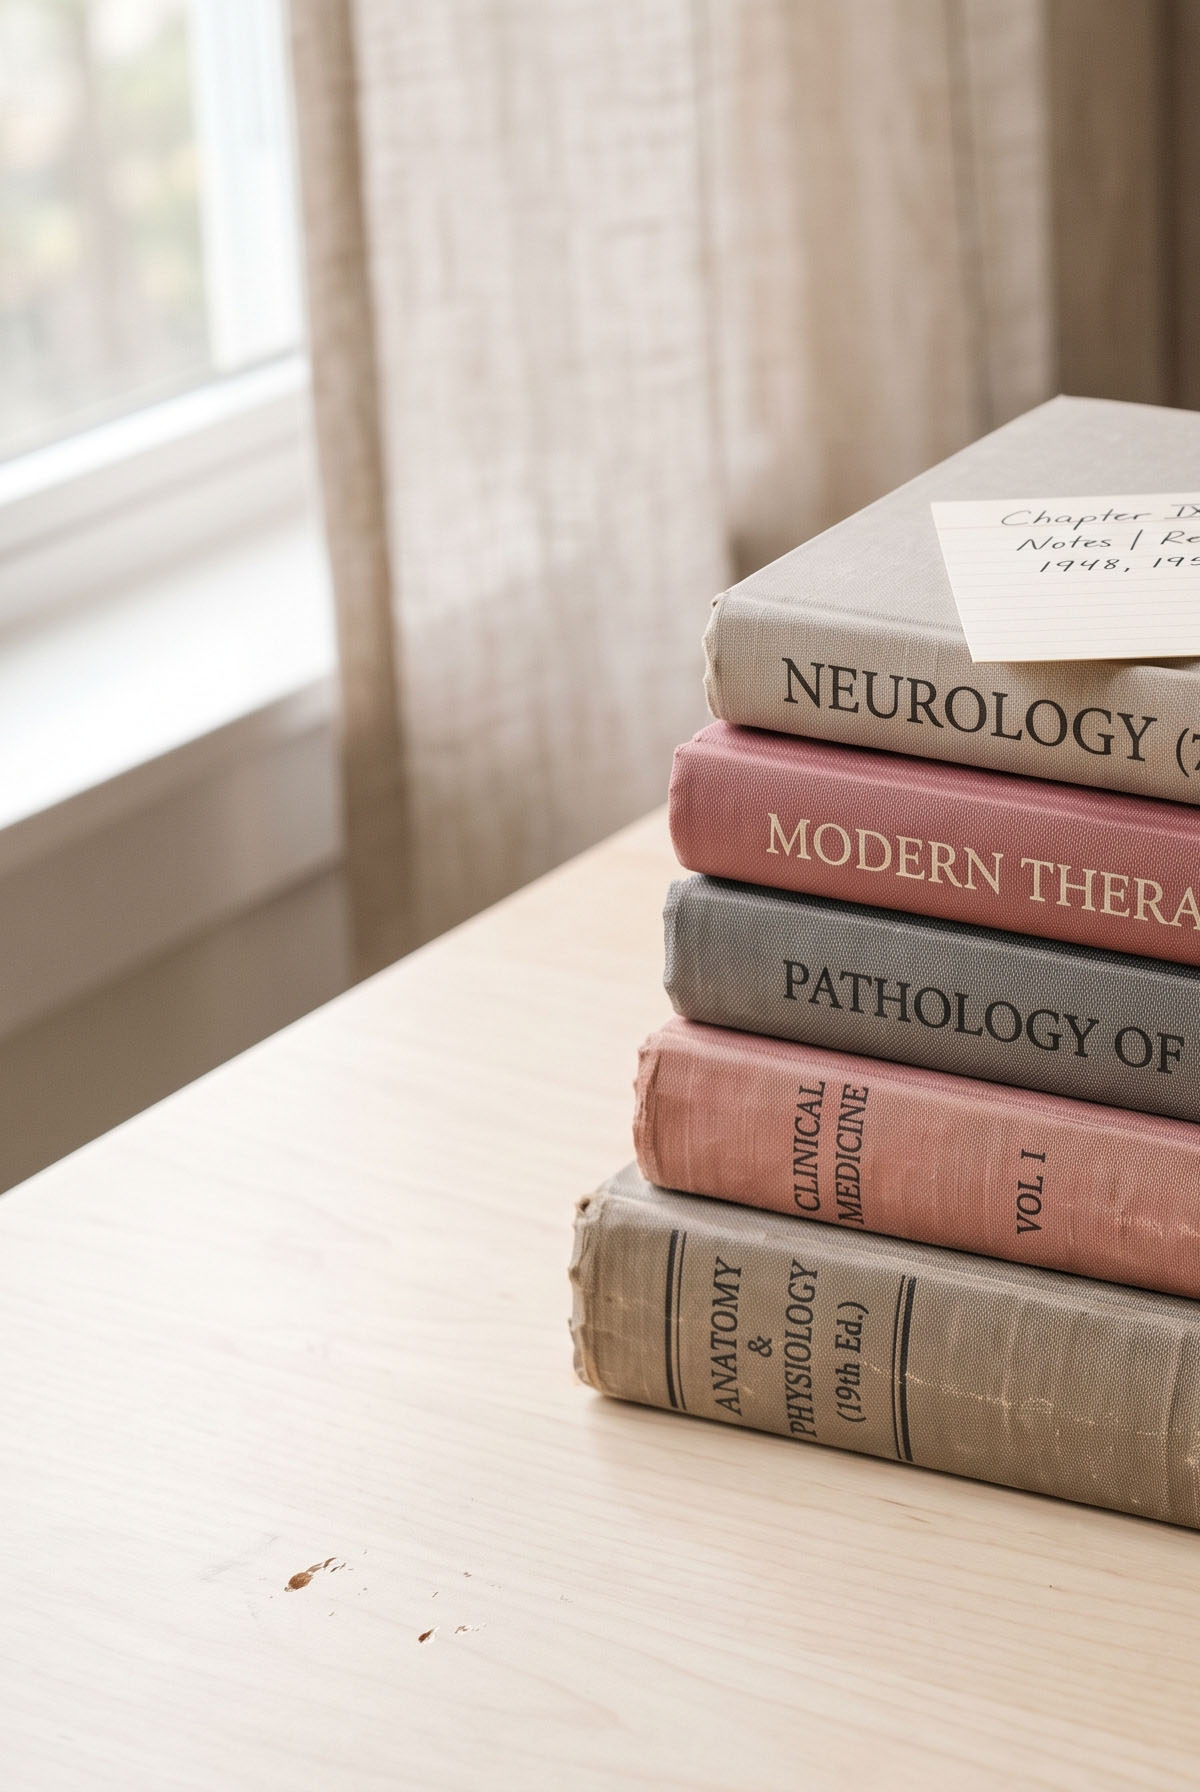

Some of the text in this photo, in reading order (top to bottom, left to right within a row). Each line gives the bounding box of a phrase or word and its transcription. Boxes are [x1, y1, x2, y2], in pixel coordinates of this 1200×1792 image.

[1001, 508, 1152, 530] Chapter
[1016, 535, 1111, 551] Notes
[1040, 558, 1130, 573] 1948,
[782, 657, 1157, 762] NEUROLOGY
[767, 813, 1003, 895] MODERN
[783, 960, 1100, 1057] PATHOLOGY
[1114, 1027, 1184, 1075] OF
[793, 1081, 825, 1211] CLINICAL
[835, 1084, 869, 1225] MEDICINE
[1016, 1149, 1046, 1234] VOL I
[710, 1257, 742, 1415] ANATOMY
[748, 1335, 772, 1357] &
[785, 1259, 818, 1437] PHYSIOLOGY
[834, 1301, 869, 1423] (19th Ed.)
